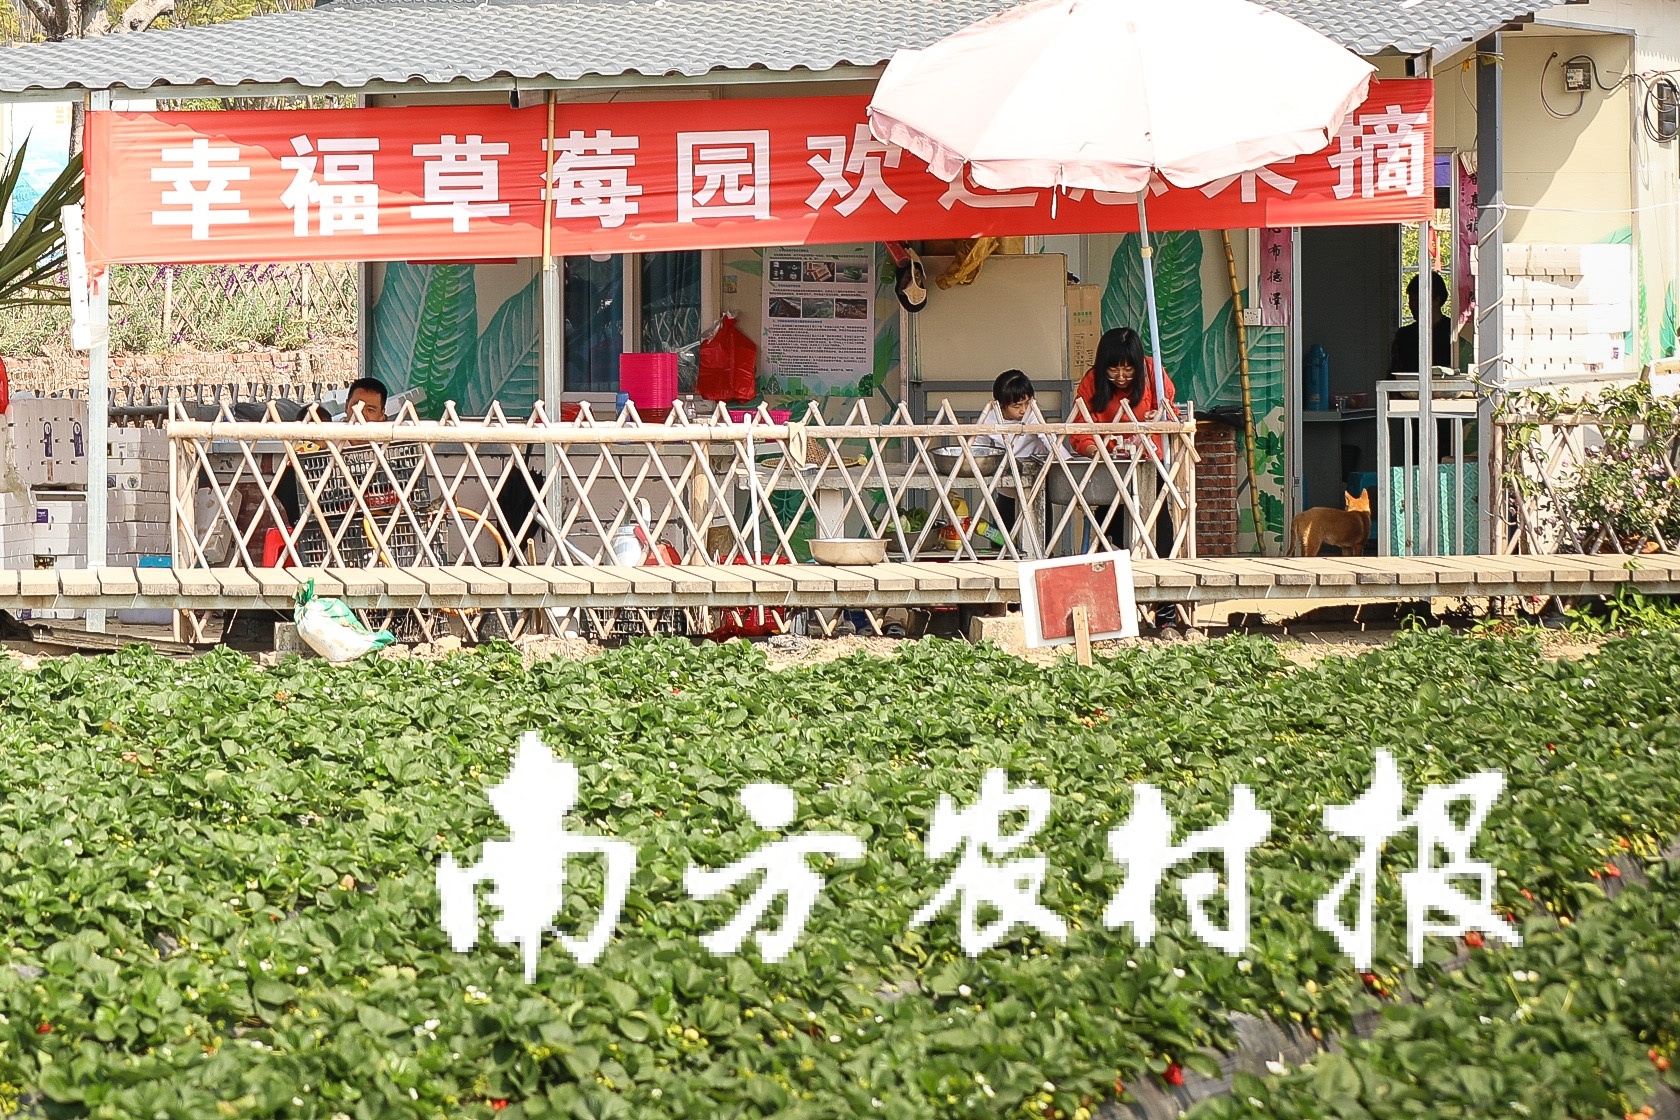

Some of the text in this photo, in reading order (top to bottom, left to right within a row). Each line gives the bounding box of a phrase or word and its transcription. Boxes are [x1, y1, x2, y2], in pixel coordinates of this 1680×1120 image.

[150, 104, 1429, 240] 幸福草莓园欢摘
